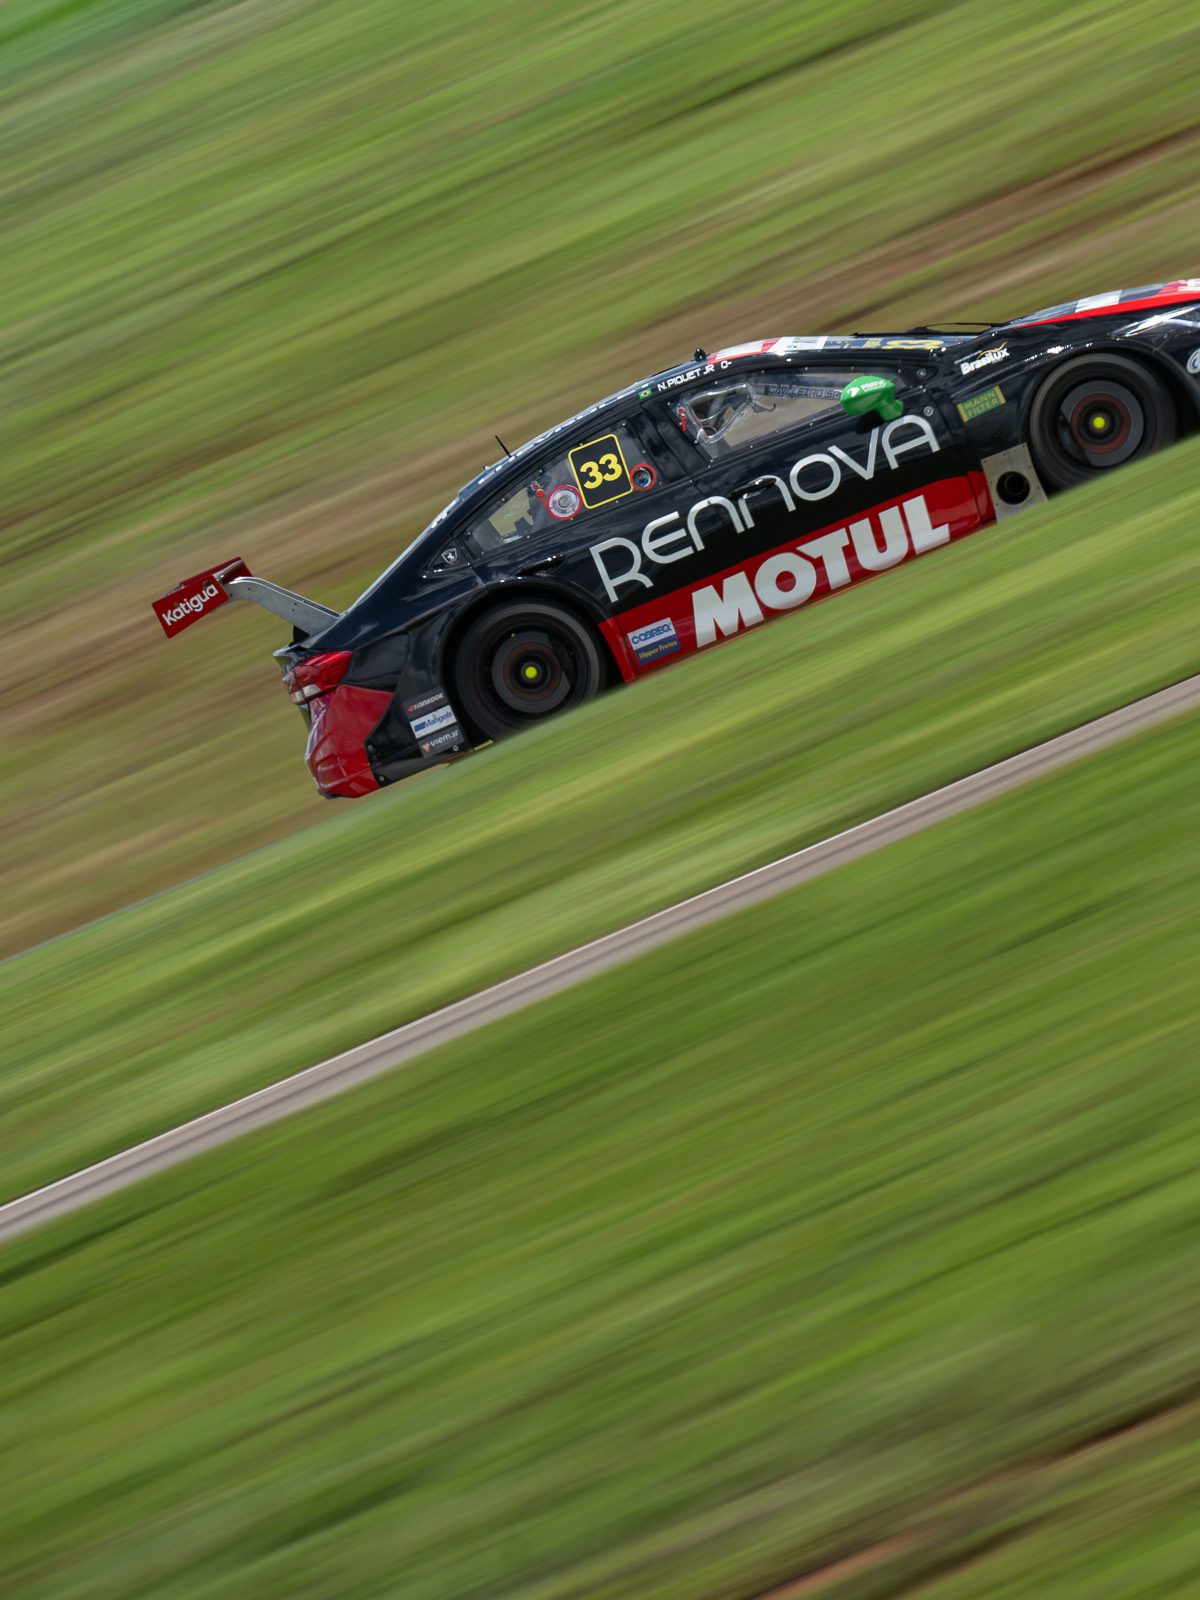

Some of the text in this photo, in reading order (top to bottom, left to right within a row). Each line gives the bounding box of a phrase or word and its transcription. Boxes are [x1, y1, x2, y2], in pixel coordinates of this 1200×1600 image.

[703, 364, 716, 375] JR
[960, 347, 1010, 375] Brasilux
[579, 453, 622, 489] 33
[691, 494, 951, 648] MOTUL
[161, 583, 219, 627] Katigua
